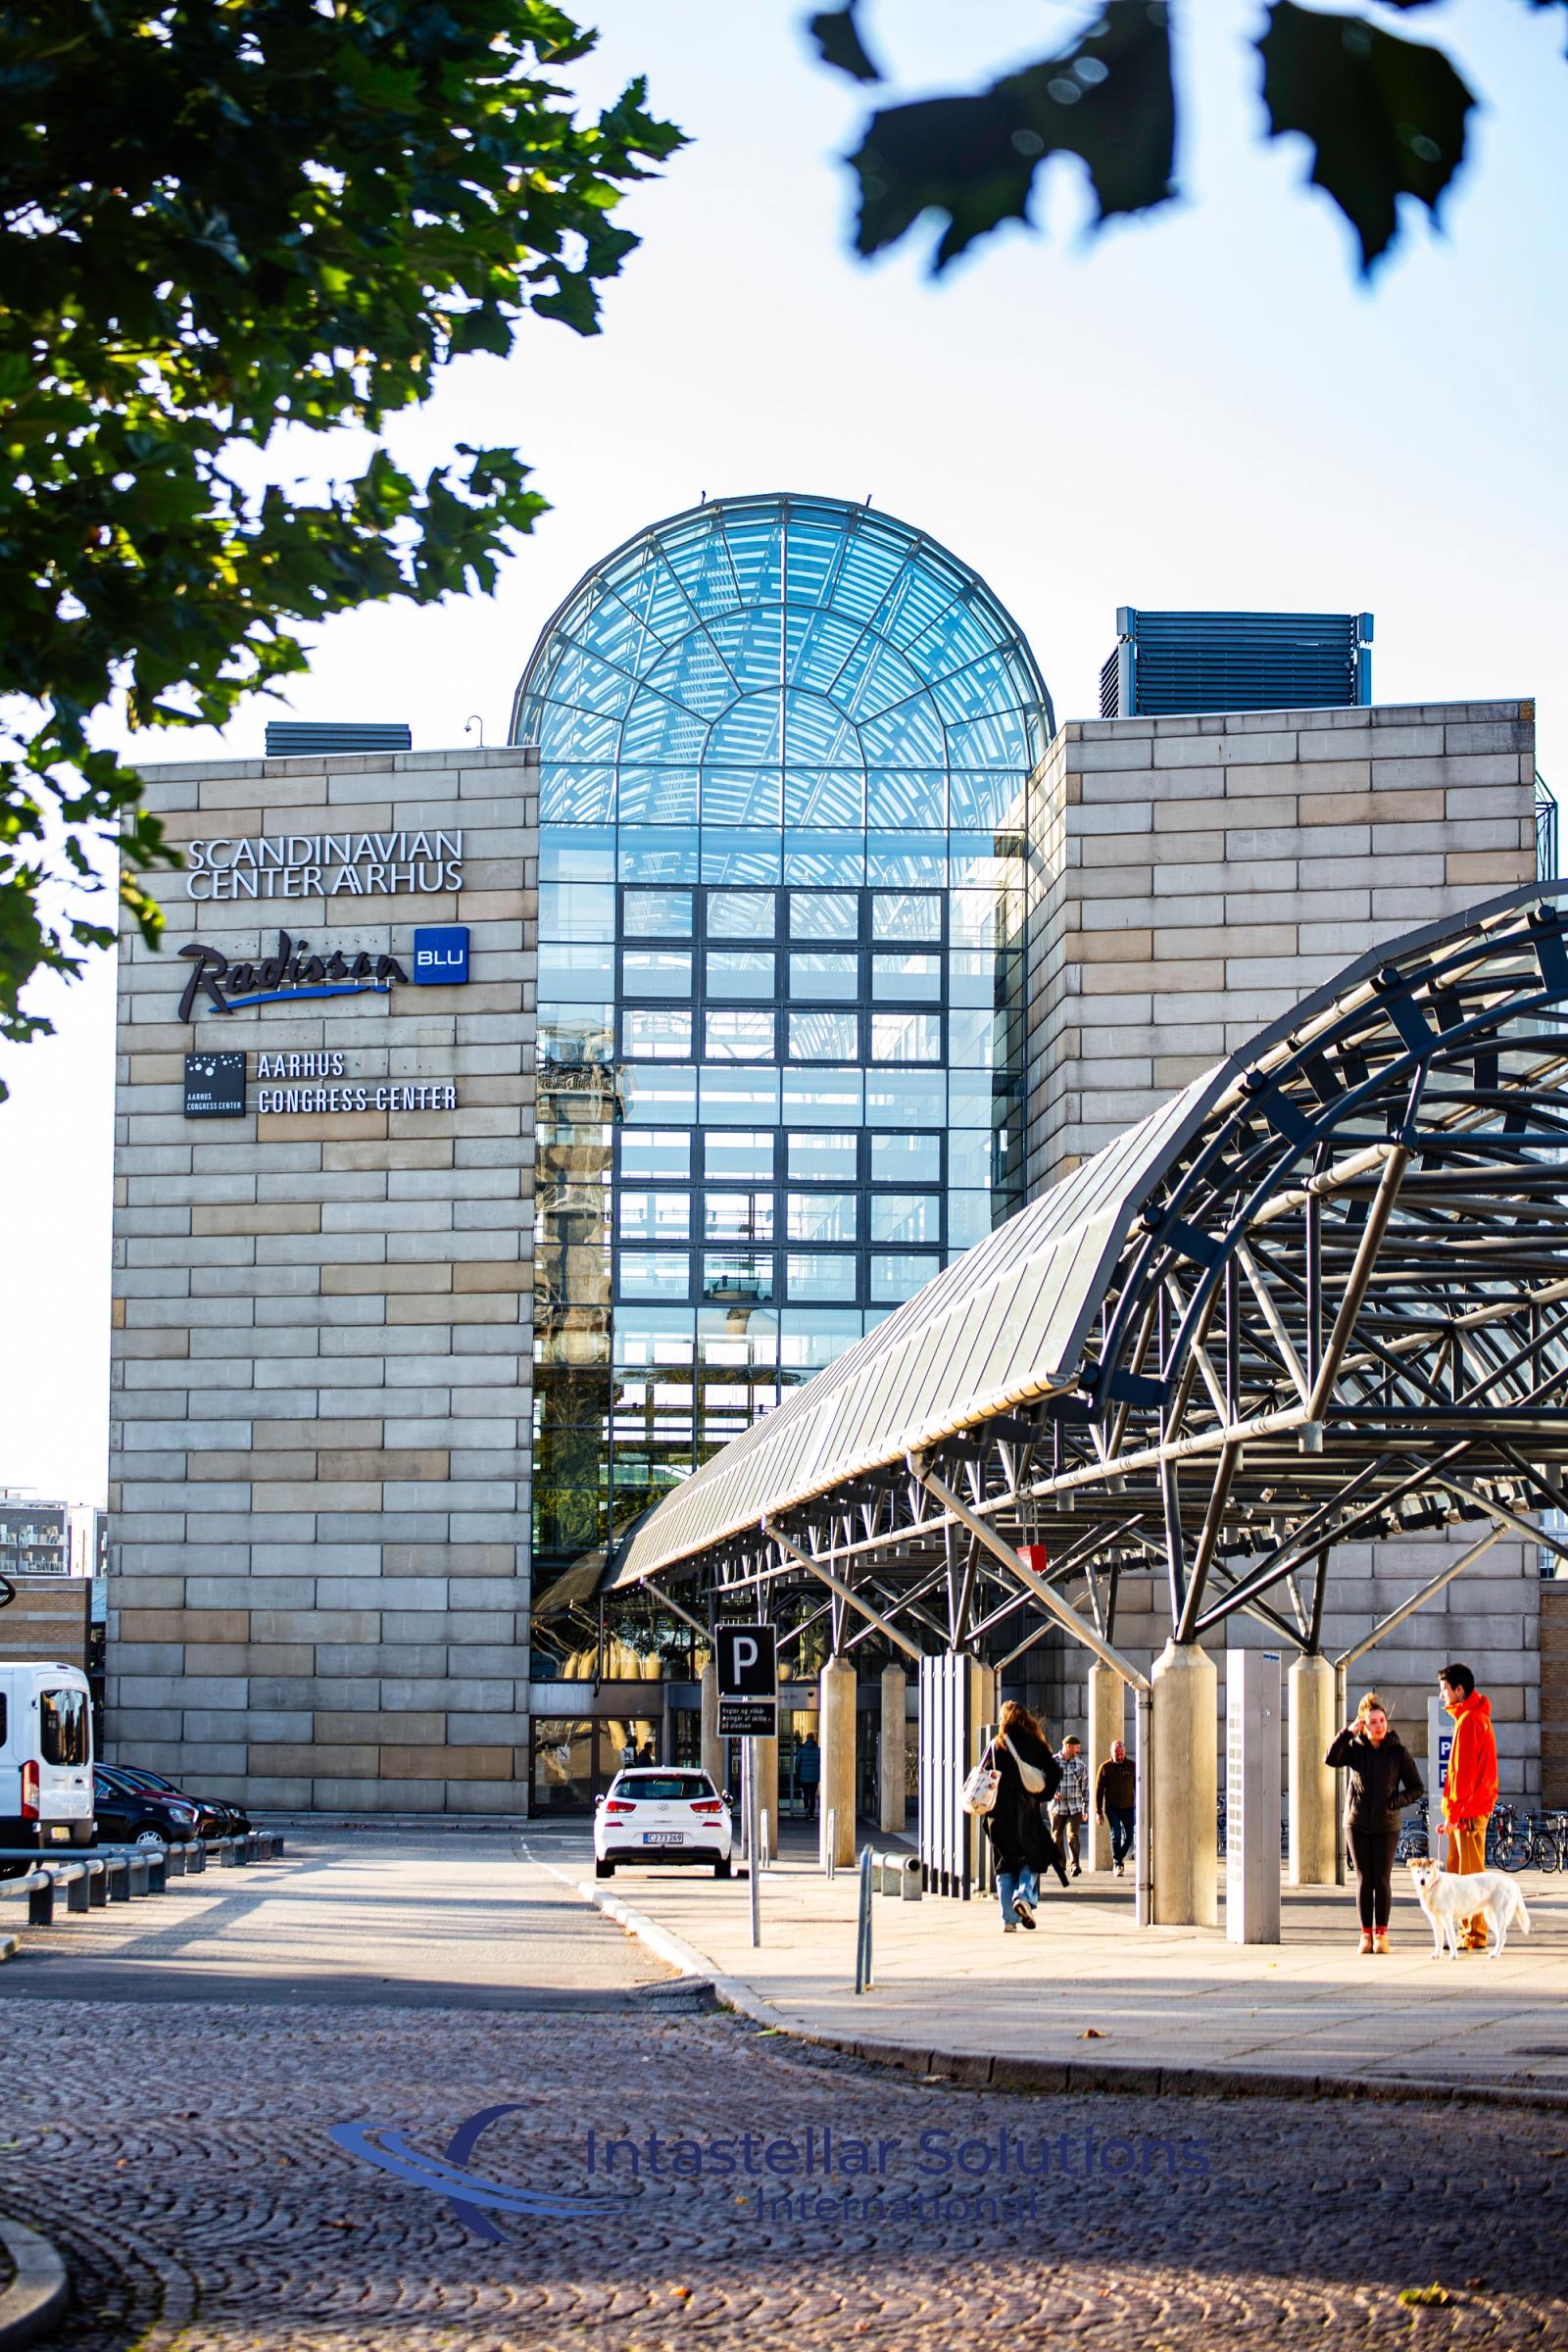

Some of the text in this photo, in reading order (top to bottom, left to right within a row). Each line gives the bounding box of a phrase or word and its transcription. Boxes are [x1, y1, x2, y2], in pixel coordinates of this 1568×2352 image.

[188, 830, 463, 870] SCANDINAVIAN
[186, 865, 324, 901] CENTER
[417, 950, 464, 966] BLU
[177, 930, 409, 1024] Radisson
[258, 1053, 343, 1078] AARHUS
[258, 1086, 457, 1113] CONGRESS CENTER
[733, 1636, 758, 1686] P
[1441, 1741, 1451, 1755] P
